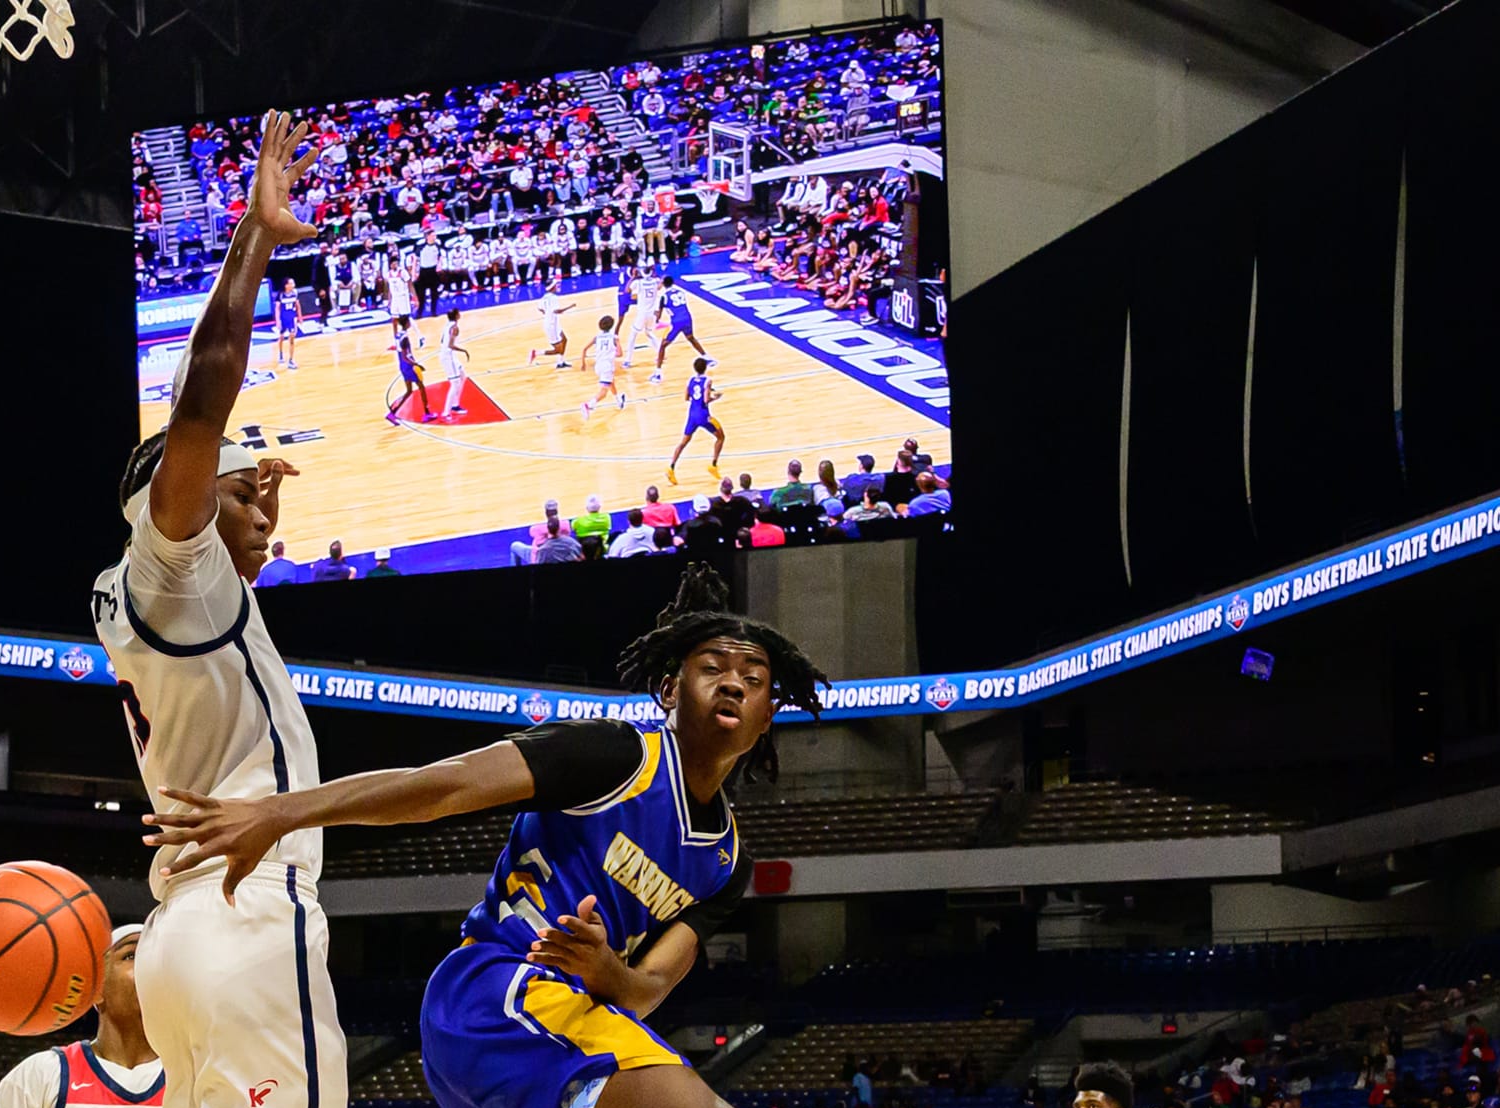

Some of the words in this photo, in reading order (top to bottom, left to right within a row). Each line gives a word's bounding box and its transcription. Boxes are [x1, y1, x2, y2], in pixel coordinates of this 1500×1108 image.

[681, 272, 950, 407] ALAMODO
[1253, 581, 1290, 615] BOYS
[1292, 548, 1383, 602] BASKETBALL
[1386, 532, 1429, 570] STATE
[964, 677, 1015, 700] BOYS
[1018, 653, 1089, 695] BASKETBALL
[1091, 641, 1122, 671] STATE
[1124, 604, 1223, 658] CHAMPIONSHIPS
[325, 676, 373, 701] STATE
[377, 682, 517, 714] CHAMPIONSHIPS
[556, 699, 603, 720] BOYS
